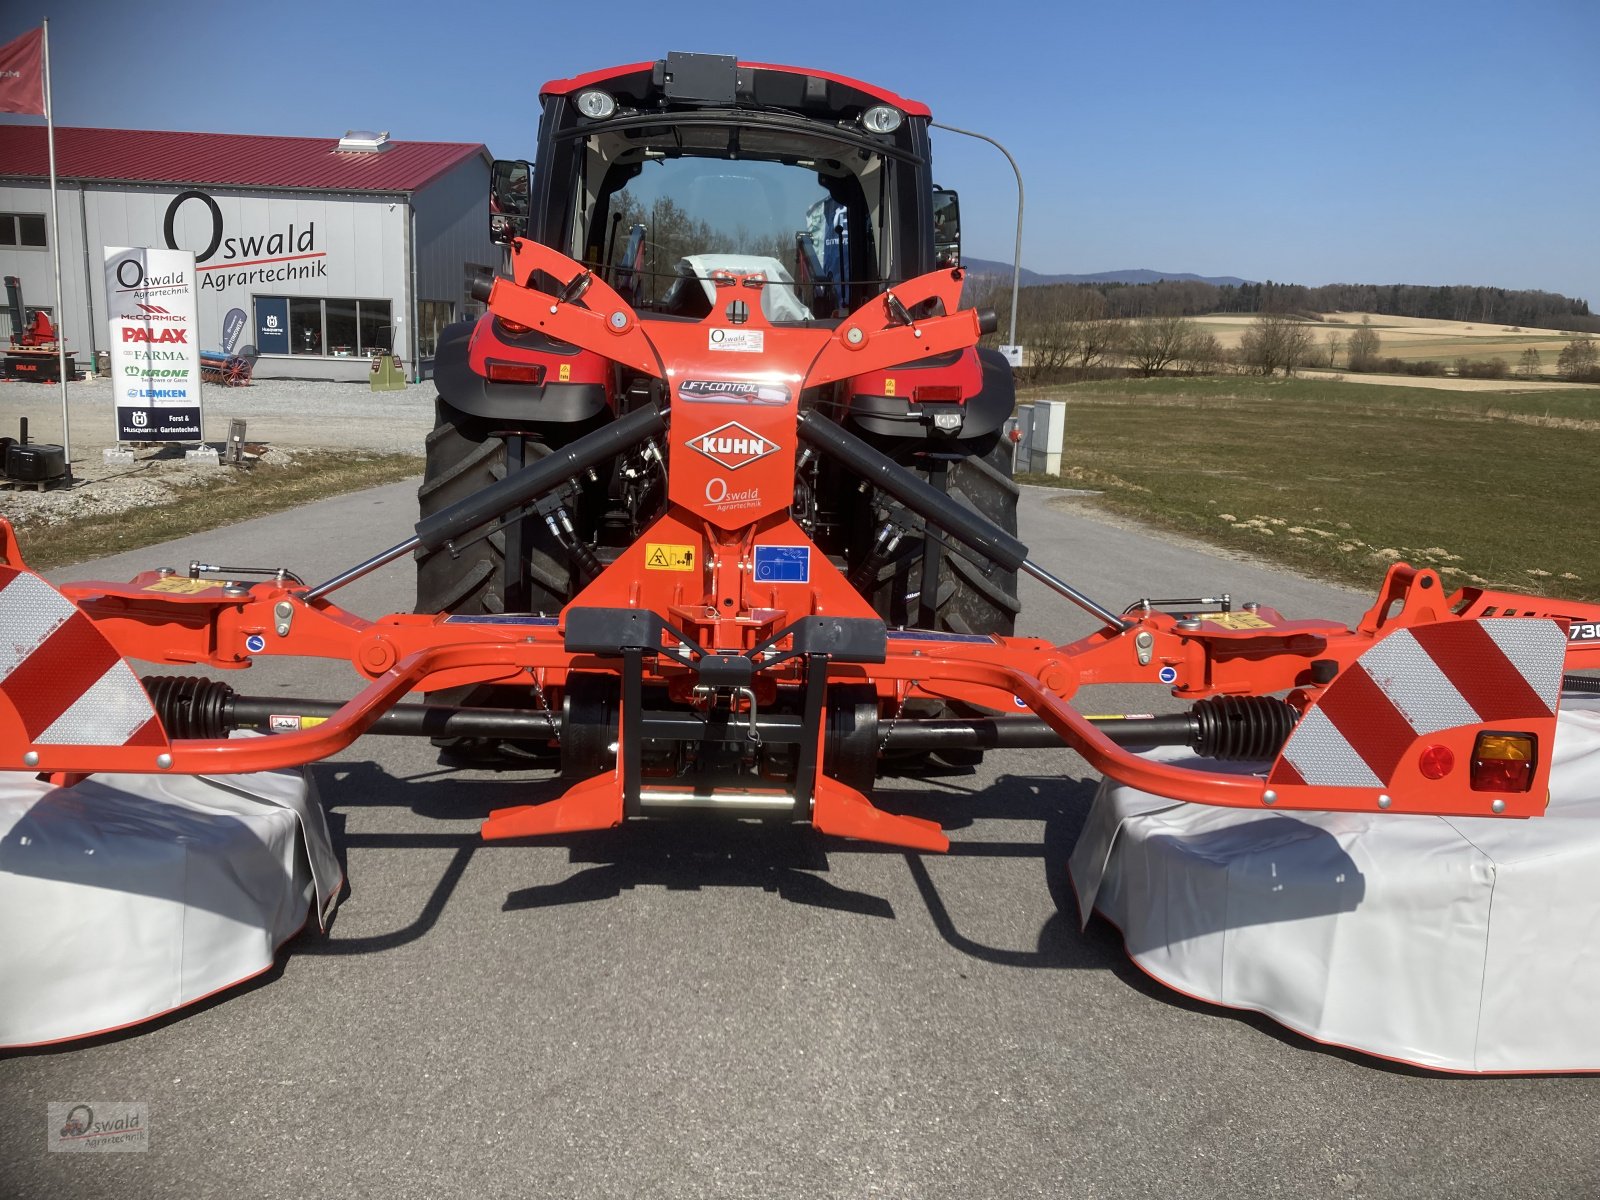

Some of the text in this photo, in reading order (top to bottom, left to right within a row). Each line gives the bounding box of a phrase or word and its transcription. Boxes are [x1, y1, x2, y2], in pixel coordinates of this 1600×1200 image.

[163, 190, 314, 263] Oswald
[116, 259, 184, 288] Oswald
[201, 259, 327, 292] Agrartechnik
[133, 287, 189, 299] Agrartechnik
[122, 327, 188, 344] PALAX
[711, 329, 745, 343] Oswald
[134, 350, 185, 360] FARMA
[140, 369, 189, 377] KRONE
[140, 389, 187, 398] LEMKEN
[681, 381, 758, 393] LIFT-CONTROL
[702, 437, 764, 455] KUHN
[705, 477, 759, 503] Oswald
[717, 501, 761, 512] Agrartechnik
